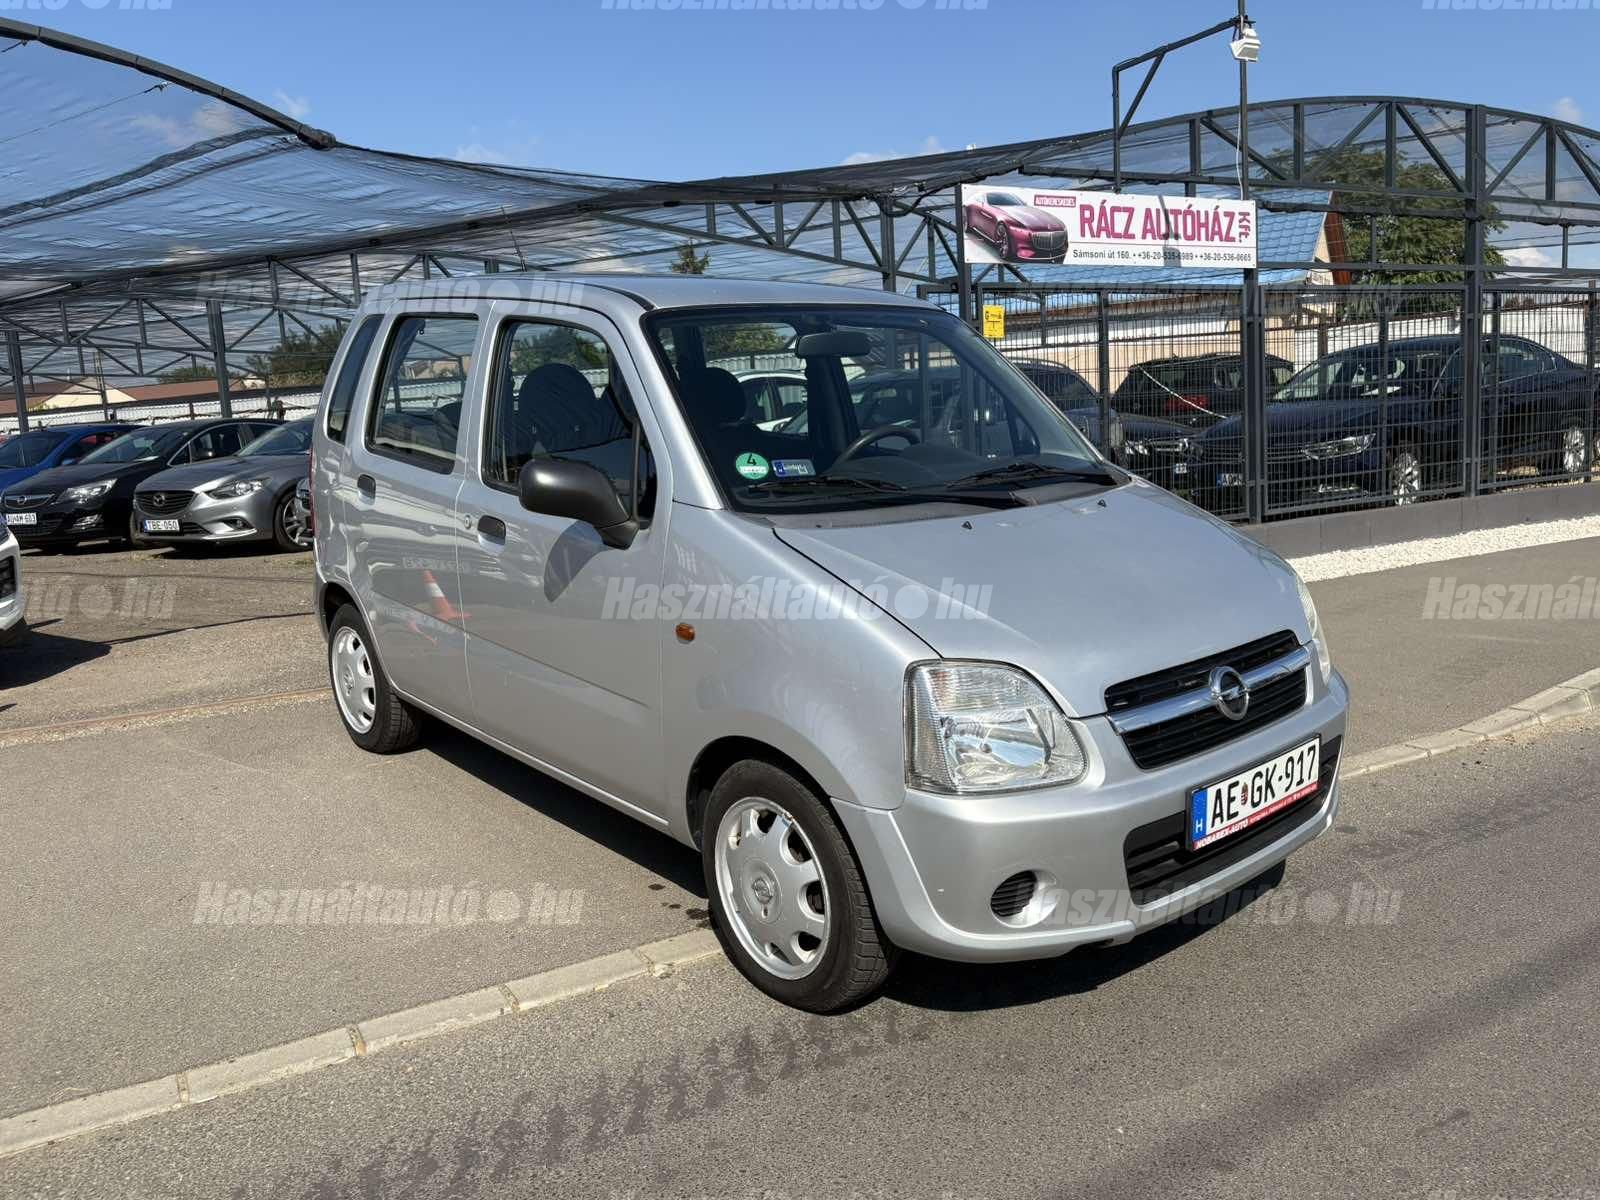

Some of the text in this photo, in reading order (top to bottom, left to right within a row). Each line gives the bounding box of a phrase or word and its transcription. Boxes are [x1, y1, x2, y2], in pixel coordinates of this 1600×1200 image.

[1079, 199, 1236, 243] RÁCZ AUTÓHÁZ
[1238, 211, 1251, 243] Kft.
[1107, 249, 1115, 259] út
